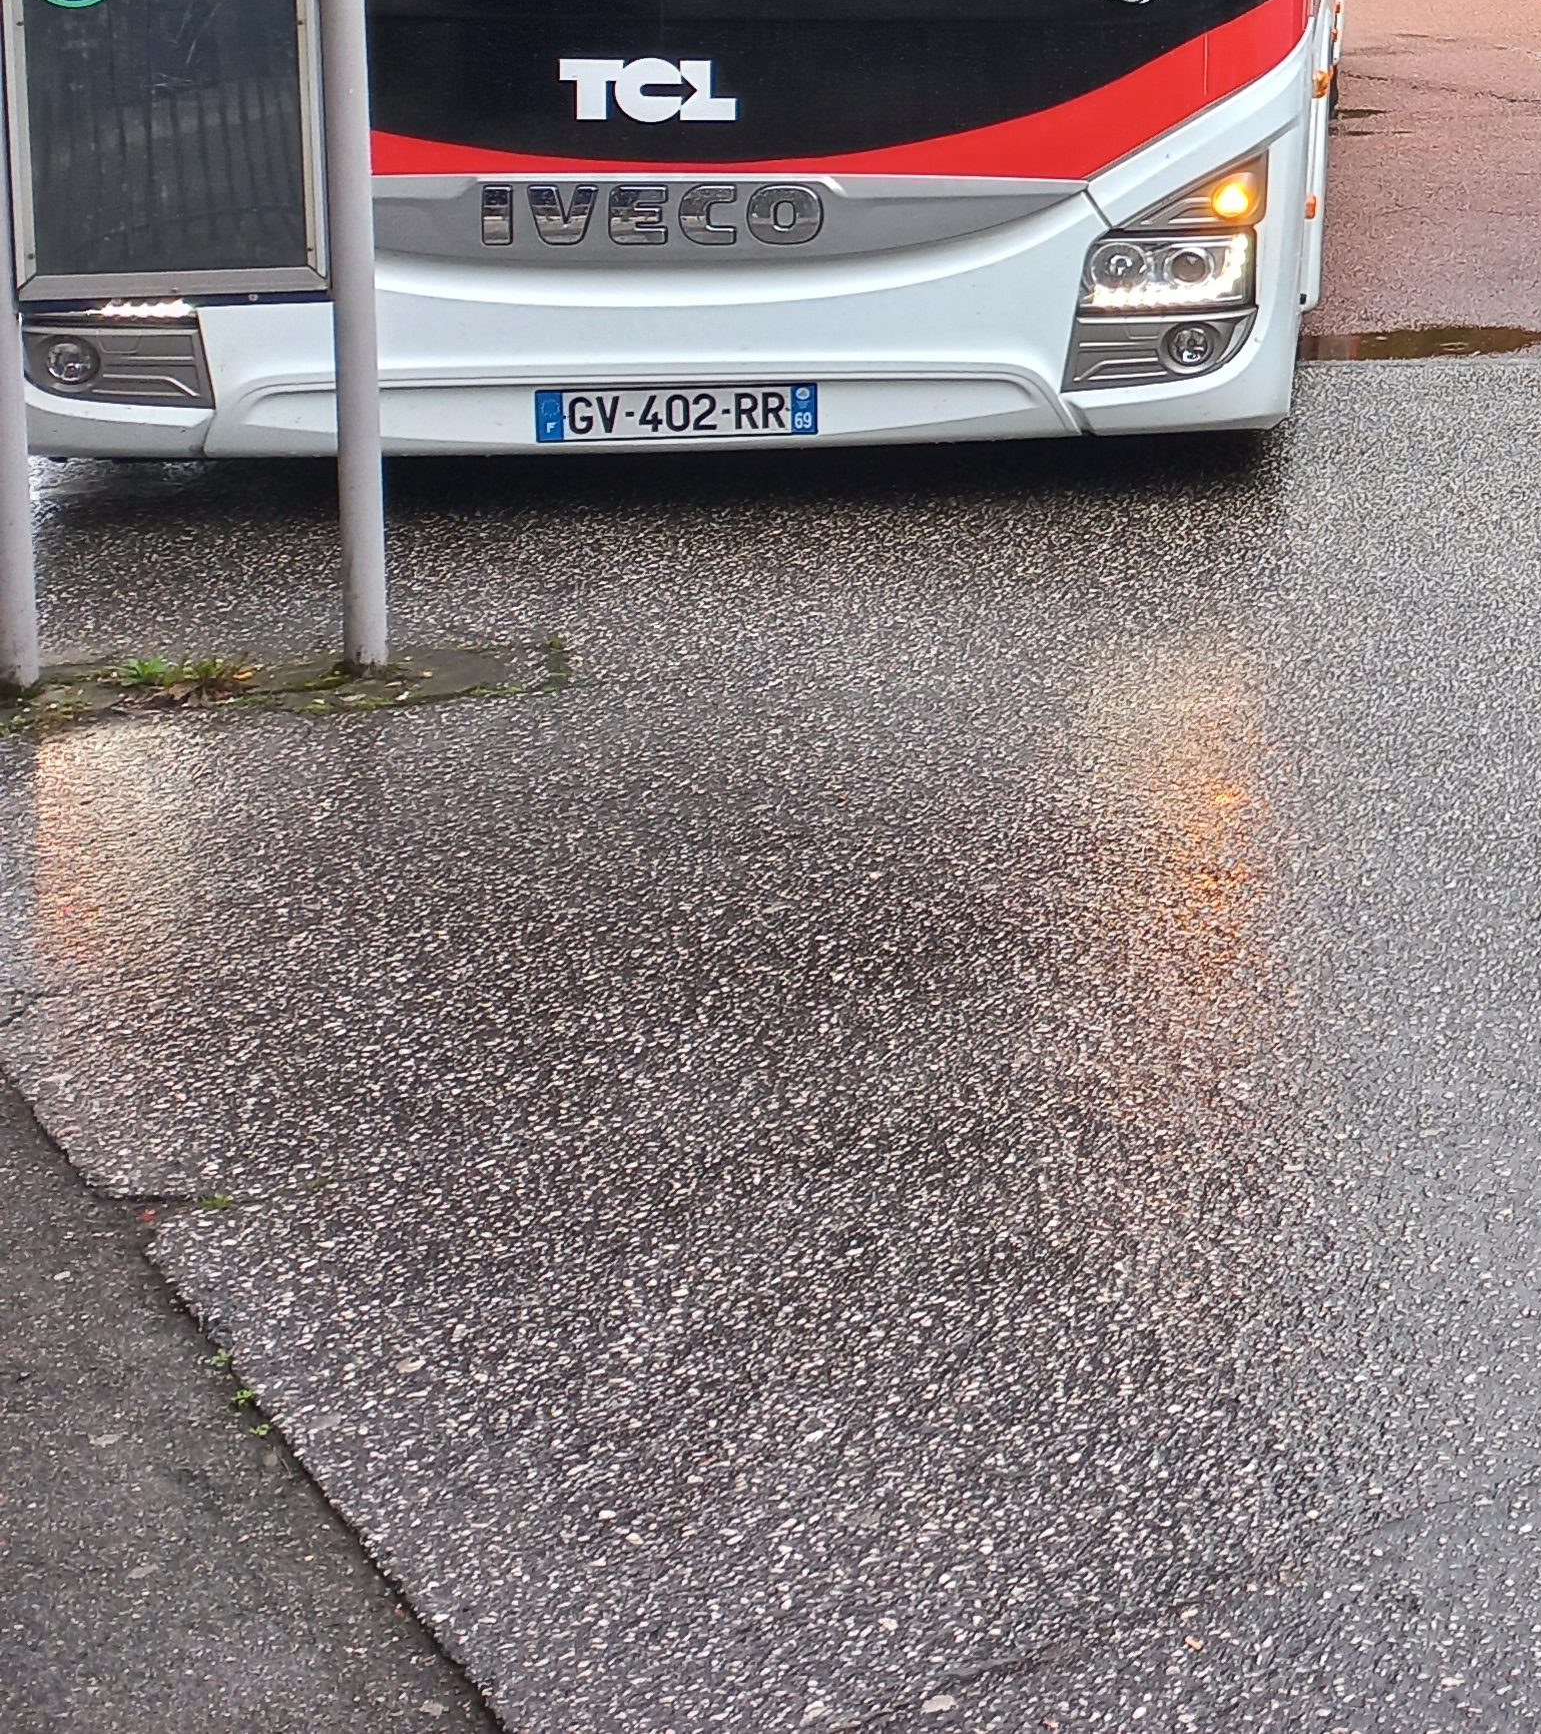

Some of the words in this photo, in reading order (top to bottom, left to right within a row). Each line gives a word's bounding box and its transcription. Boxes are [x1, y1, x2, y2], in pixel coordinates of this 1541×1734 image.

[559, 57, 738, 123] TCL
[481, 184, 824, 247] IVECO
[546, 422, 557, 434] F
[567, 392, 786, 434] GV-402-RR
[794, 411, 812, 430] 69
